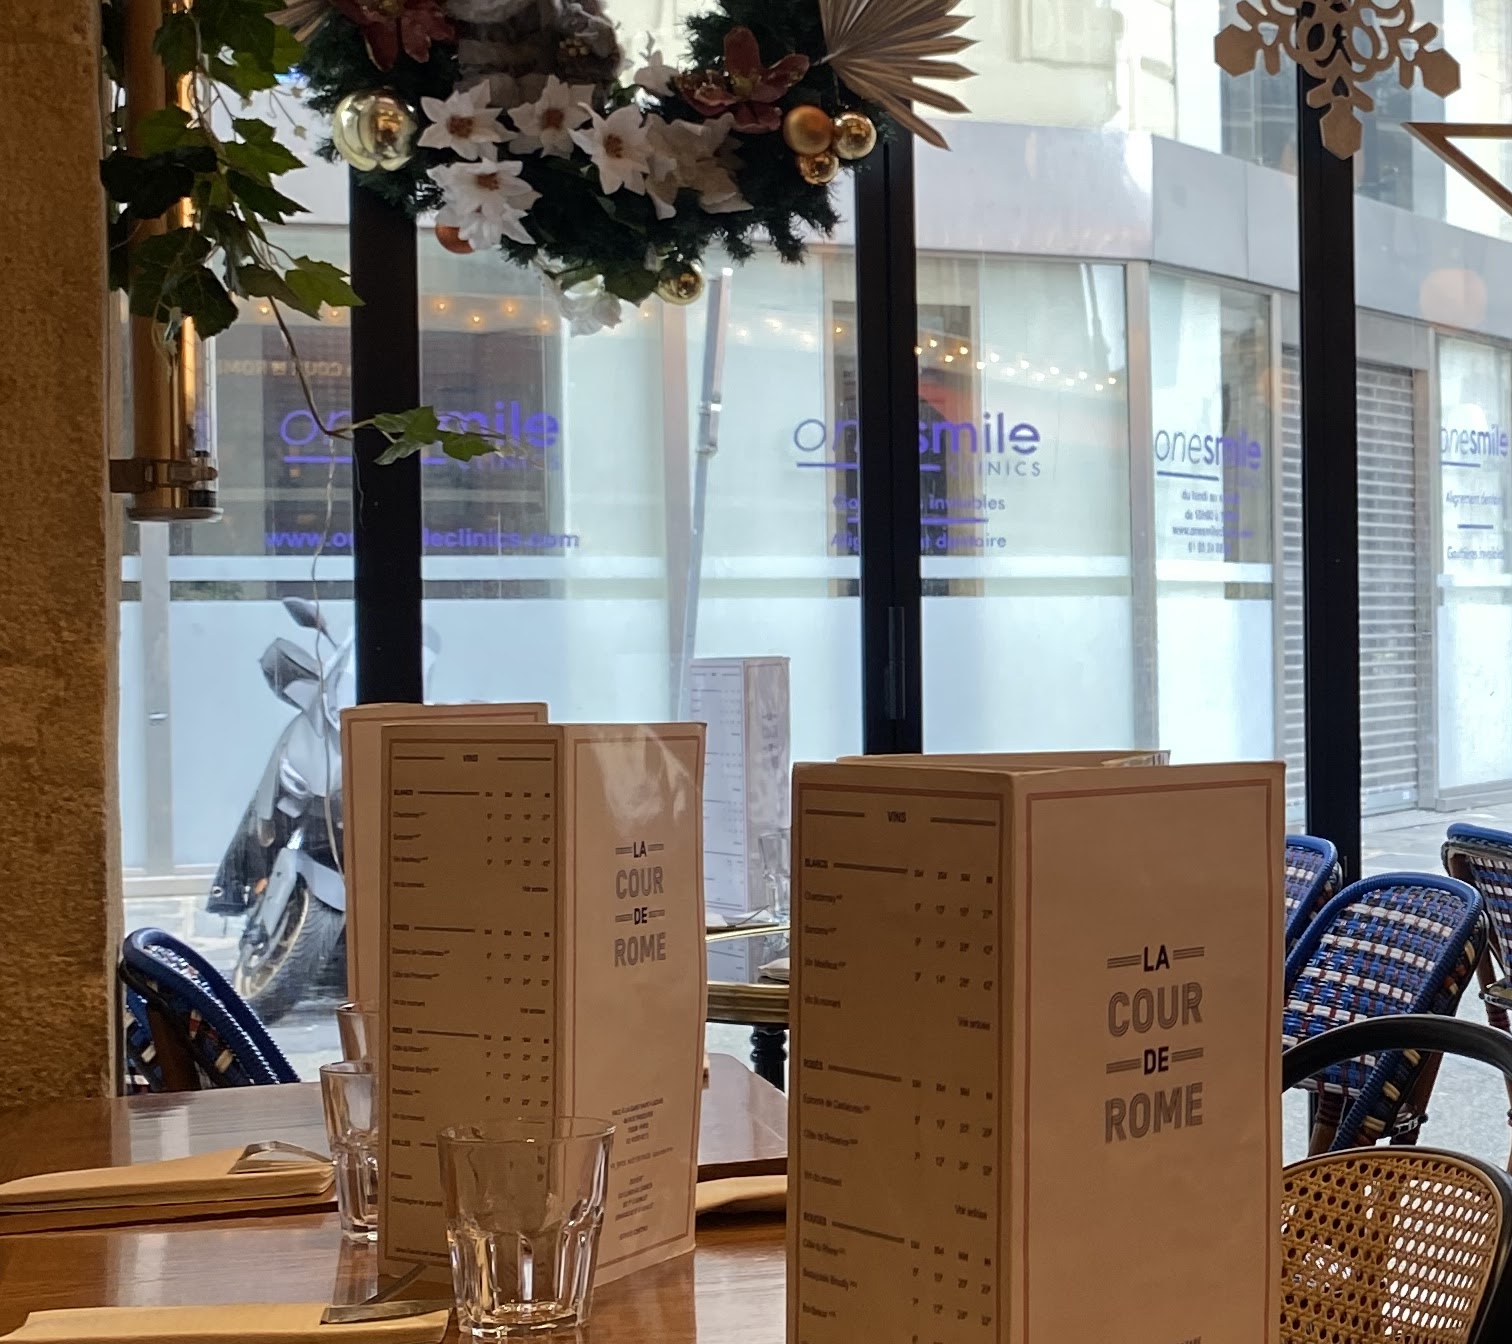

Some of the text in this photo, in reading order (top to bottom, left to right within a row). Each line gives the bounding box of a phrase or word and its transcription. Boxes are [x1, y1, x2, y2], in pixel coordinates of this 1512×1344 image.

[1155, 430, 1261, 470] onesmile
[633, 841, 648, 859] LA
[615, 866, 665, 900] COUR
[633, 907, 649, 925] DE
[614, 932, 667, 968] ROME
[1143, 944, 1170, 972] LA
[1107, 981, 1204, 1038] COUR
[1143, 1045, 1170, 1076] DE
[1105, 1082, 1204, 1145] ROME
